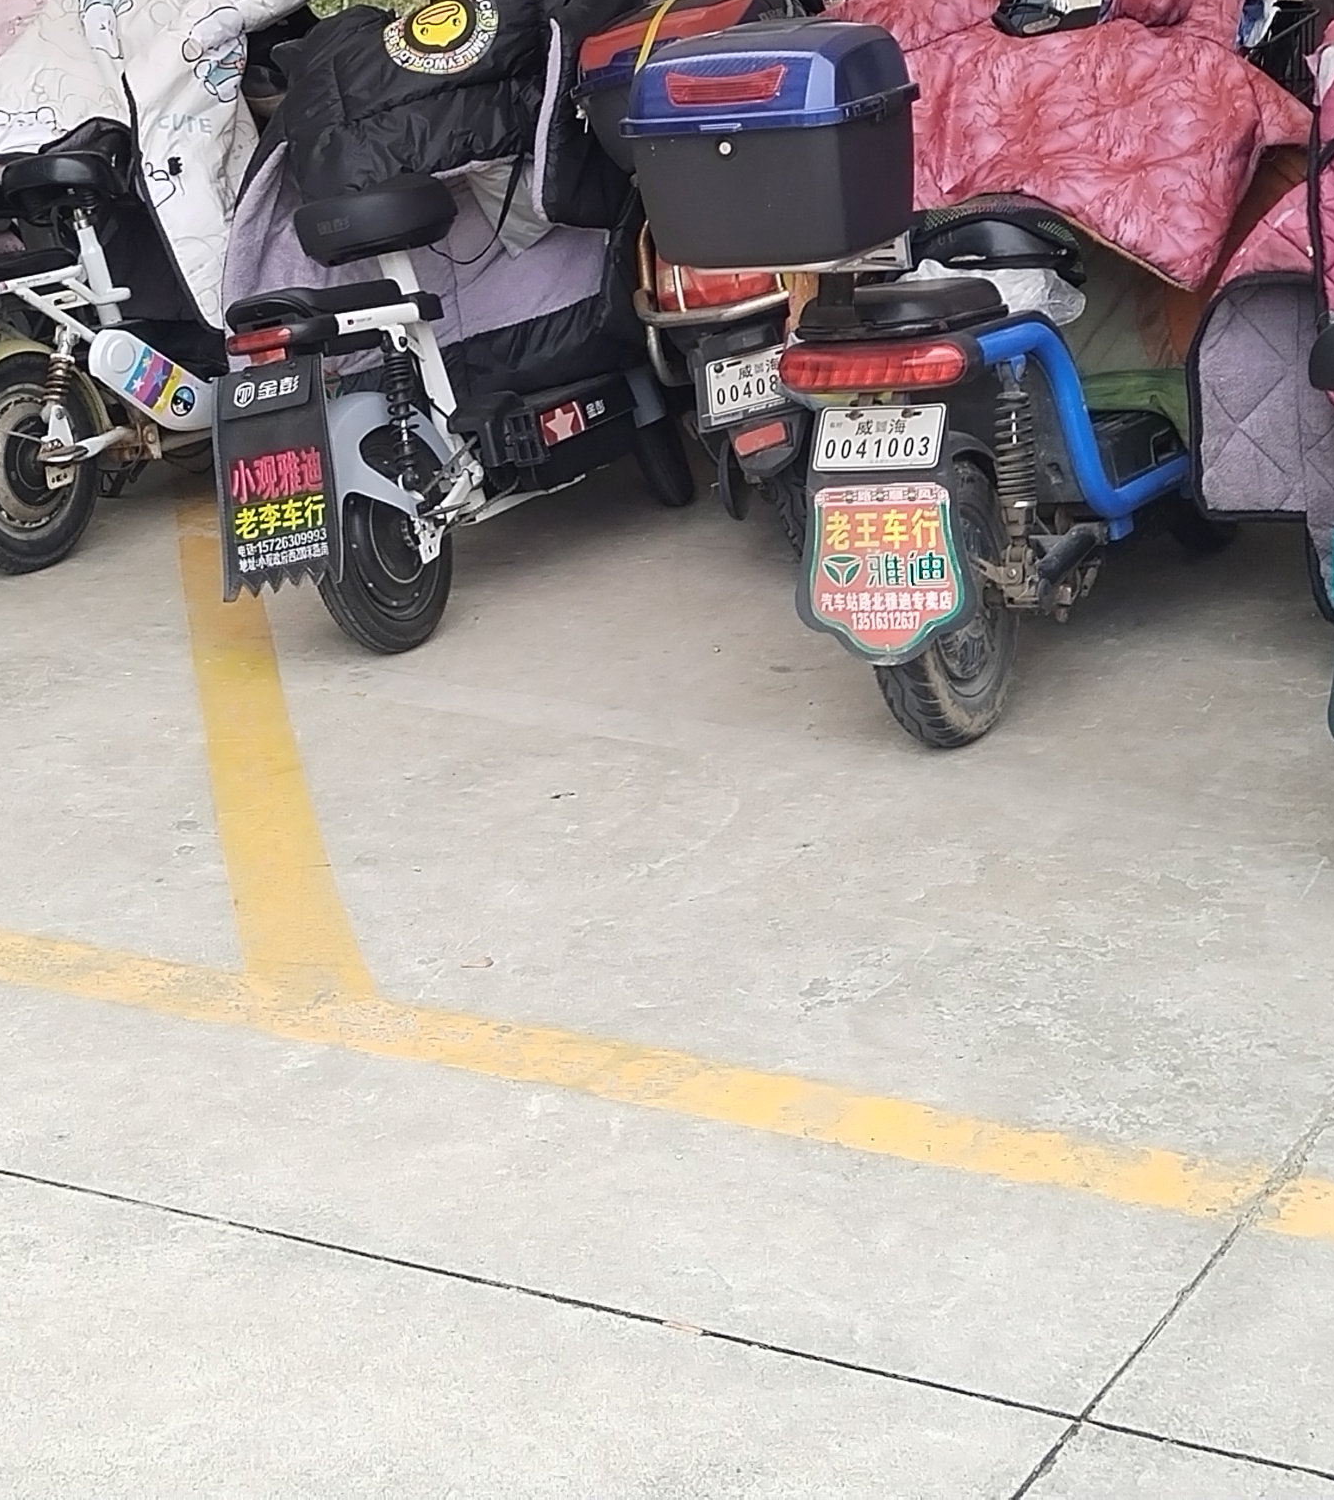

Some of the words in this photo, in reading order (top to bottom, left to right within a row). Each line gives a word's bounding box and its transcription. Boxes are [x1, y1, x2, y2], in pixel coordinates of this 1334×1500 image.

[158, 112, 212, 134] CUTE
[256, 374, 300, 400] 金彭
[824, 436, 930, 459] 0041003
[231, 447, 324, 504] 小观雅迪
[234, 494, 326, 541] 老李车行
[825, 508, 940, 550] 老王车行
[865, 550, 951, 587] 雅迪
[851, 611, 921, 630] 13516312637
